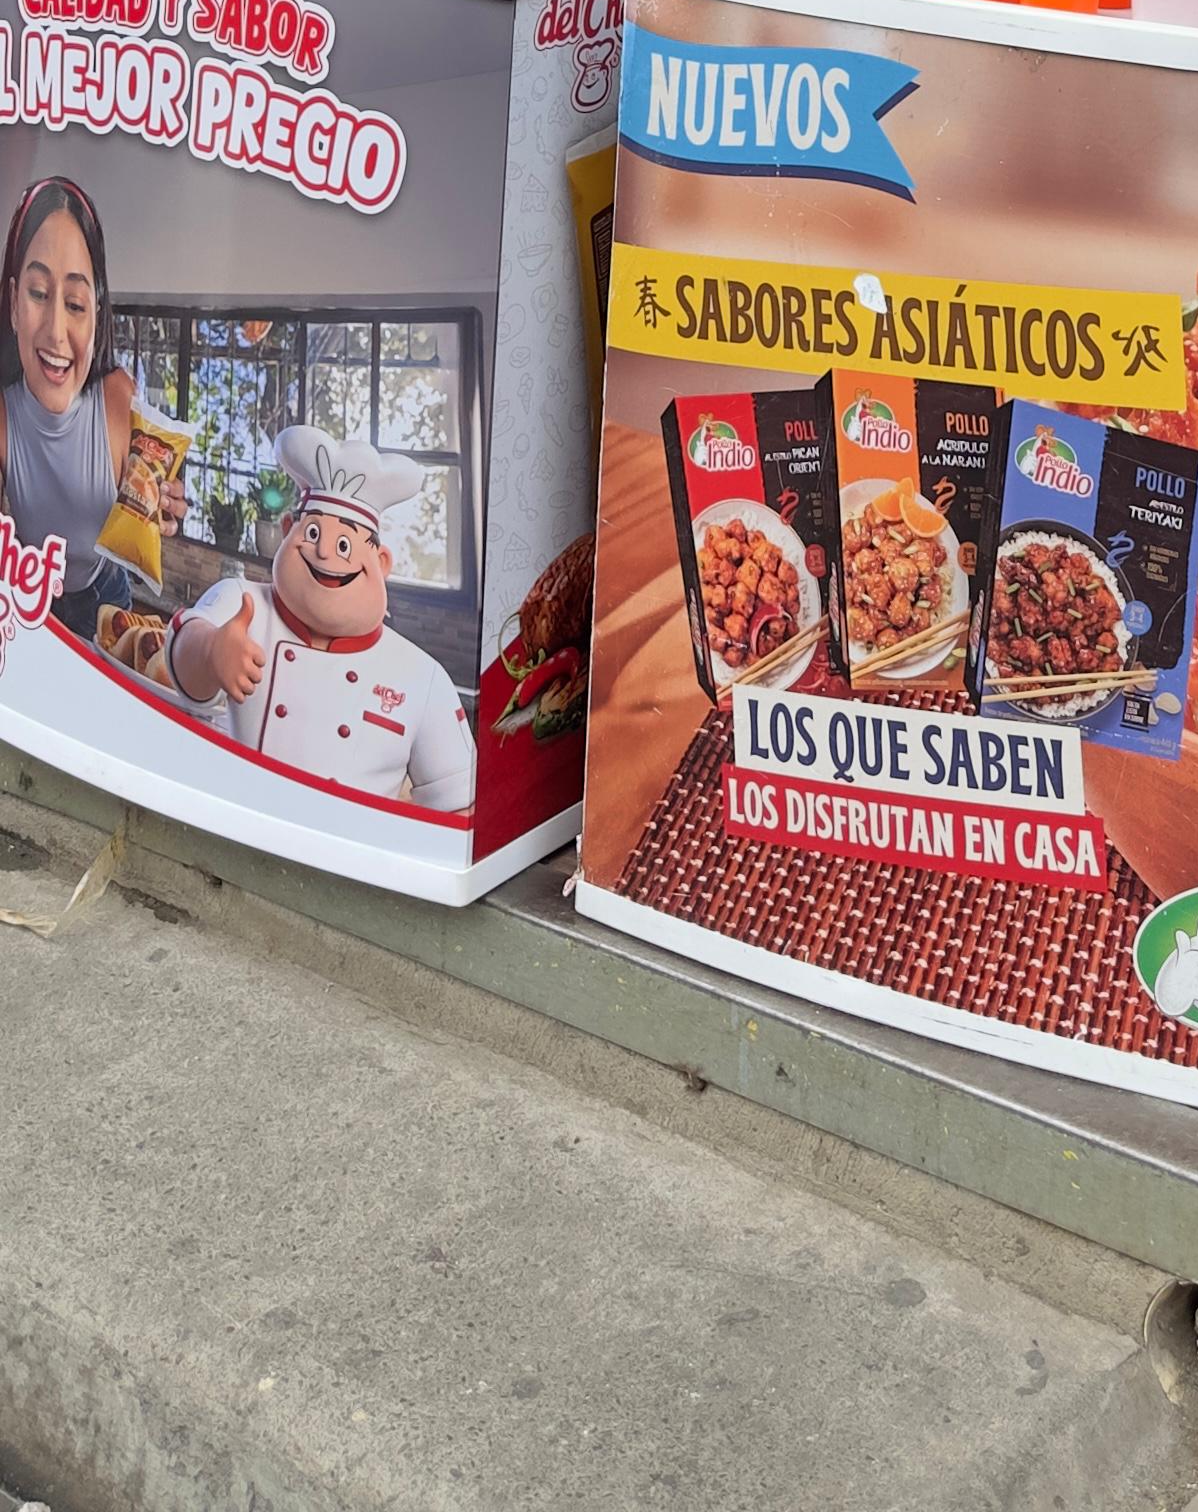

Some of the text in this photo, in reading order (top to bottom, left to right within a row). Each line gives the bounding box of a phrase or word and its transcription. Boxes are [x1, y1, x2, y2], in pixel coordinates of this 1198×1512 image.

[25, 33, 182, 136] MEJOR
[198, 70, 397, 202] PRECIO
[647, 51, 852, 154] NUEVOS
[676, 274, 859, 357] SABORES
[869, 284, 1105, 381] ASIÁTICOS
[784, 420, 819, 442] POLL
[861, 422, 912, 451] Indio
[945, 411, 989, 437] POLLO
[707, 440, 755, 470] Indio
[792, 446, 820, 459] PICAN
[930, 455, 941, 466] LA
[1045, 455, 1069, 470] Pollo
[788, 461, 821, 475] ORIENT
[1034, 455, 1092, 496] Indio
[1135, 466, 1186, 499] POLLO
[1128, 505, 1183, 530] TERIYAKI
[0, 522, 62, 622] hef
[748, 698, 1064, 800] LOS QUE SABEN
[728, 778, 1101, 878] LOS DISFRUTAN EN CASA
